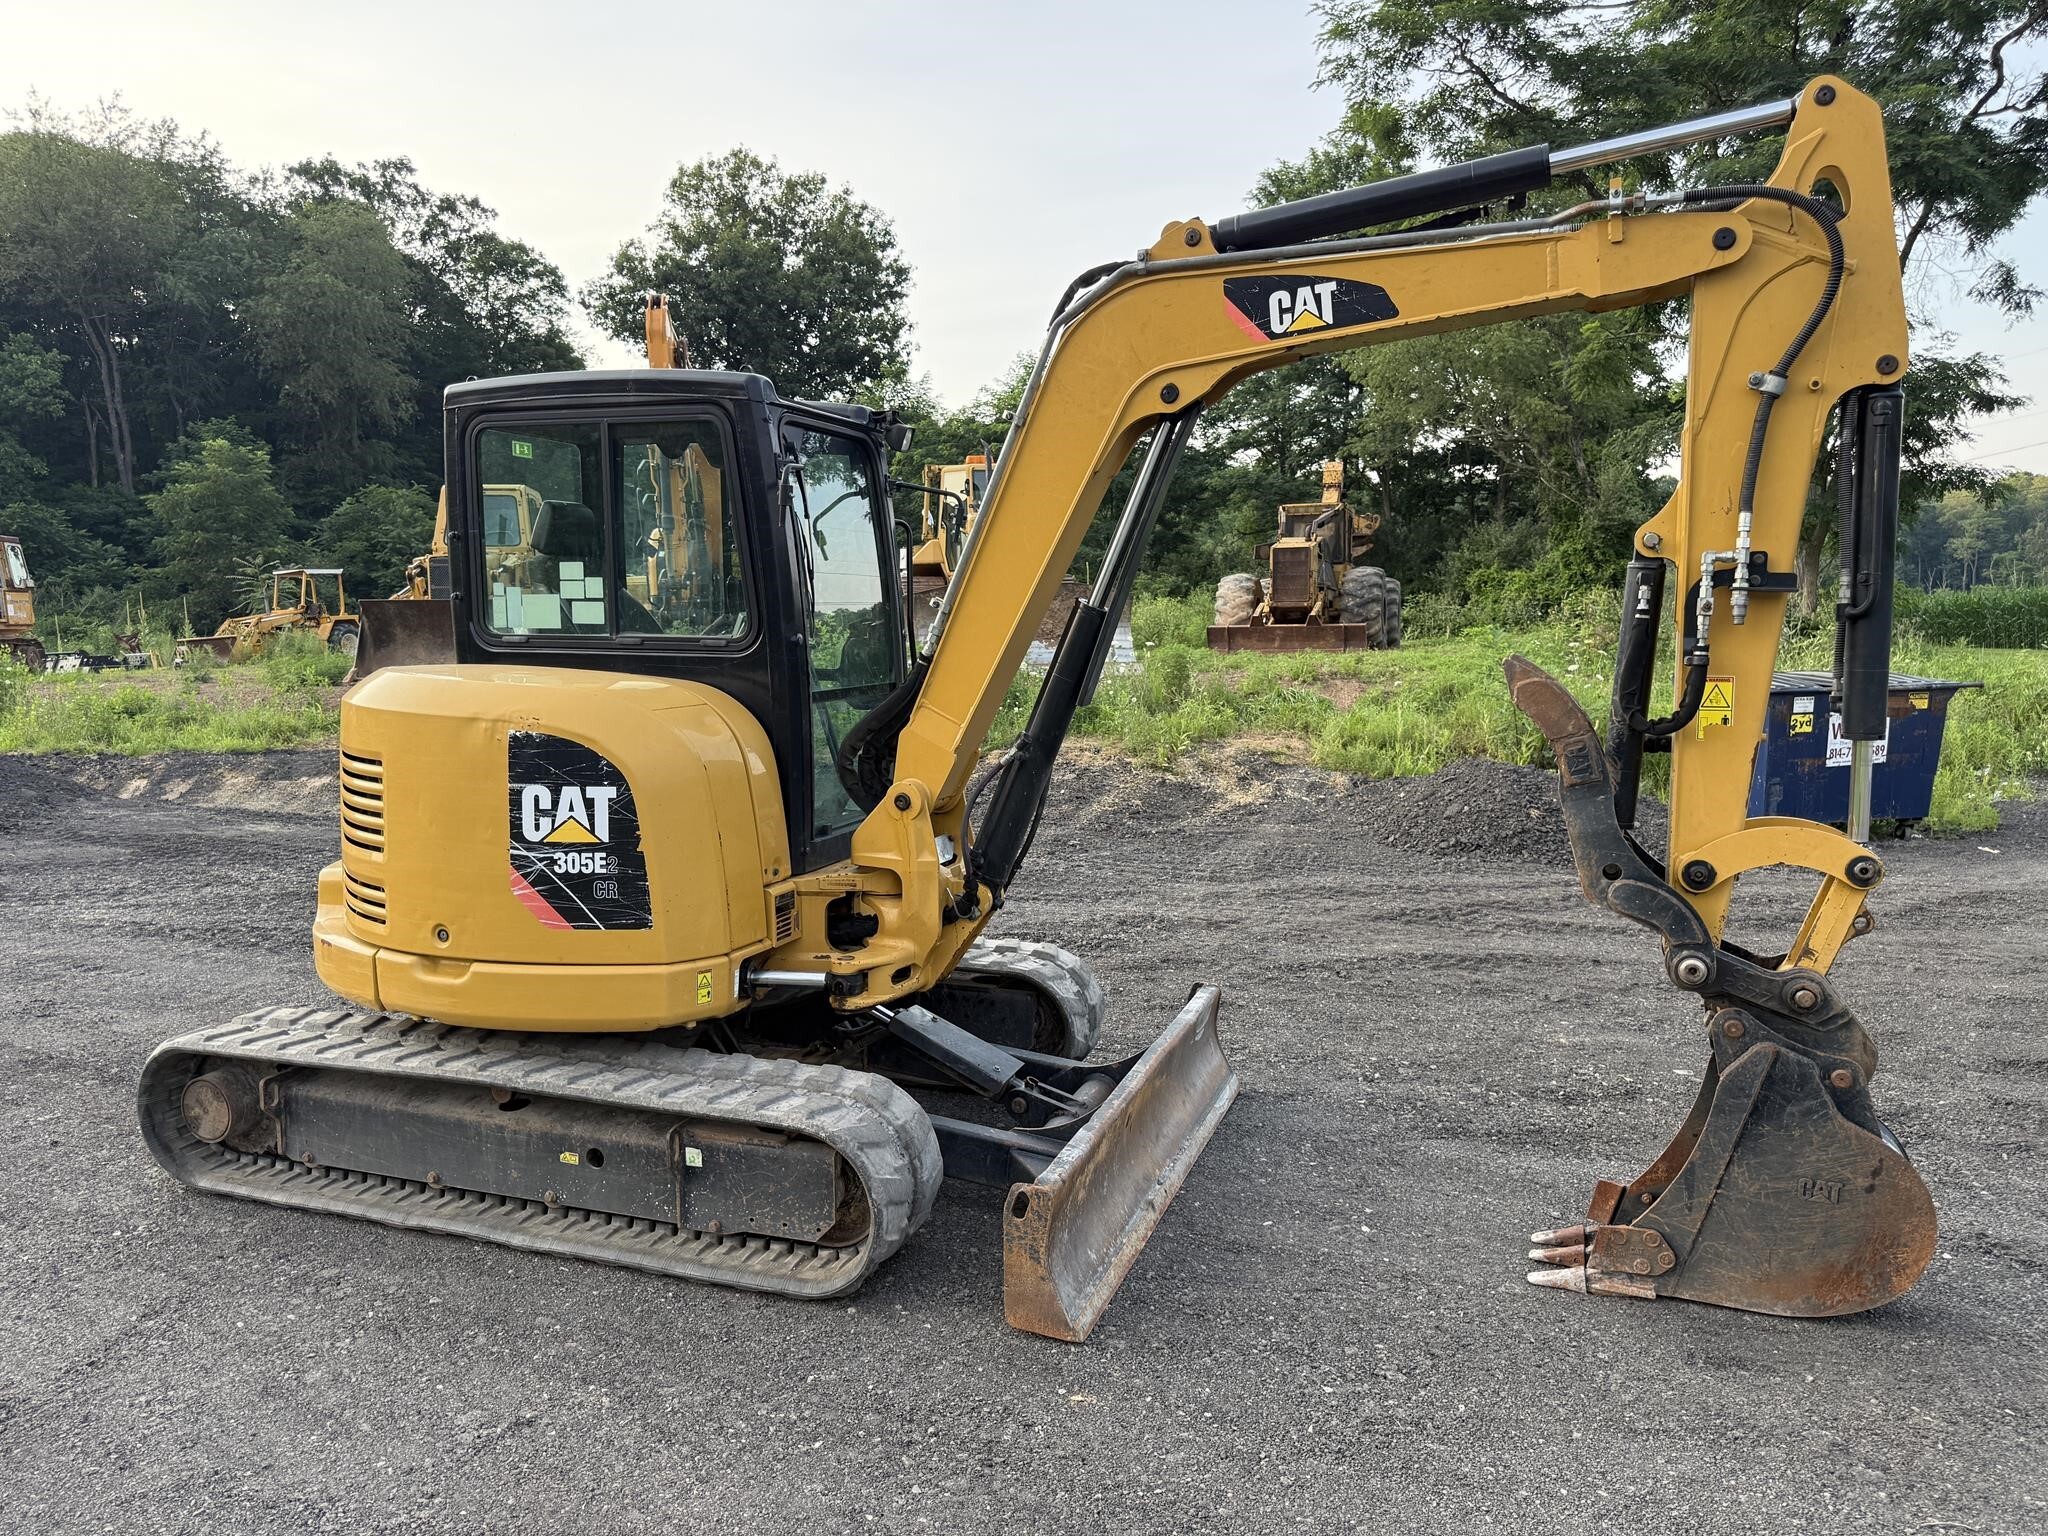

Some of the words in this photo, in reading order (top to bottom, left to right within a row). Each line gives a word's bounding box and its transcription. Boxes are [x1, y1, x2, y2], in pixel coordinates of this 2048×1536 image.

[1269, 281, 1337, 334] CAT
[521, 785, 617, 842] CAT
[593, 880, 618, 898] CR
[1798, 1177, 1844, 1205] CAT
